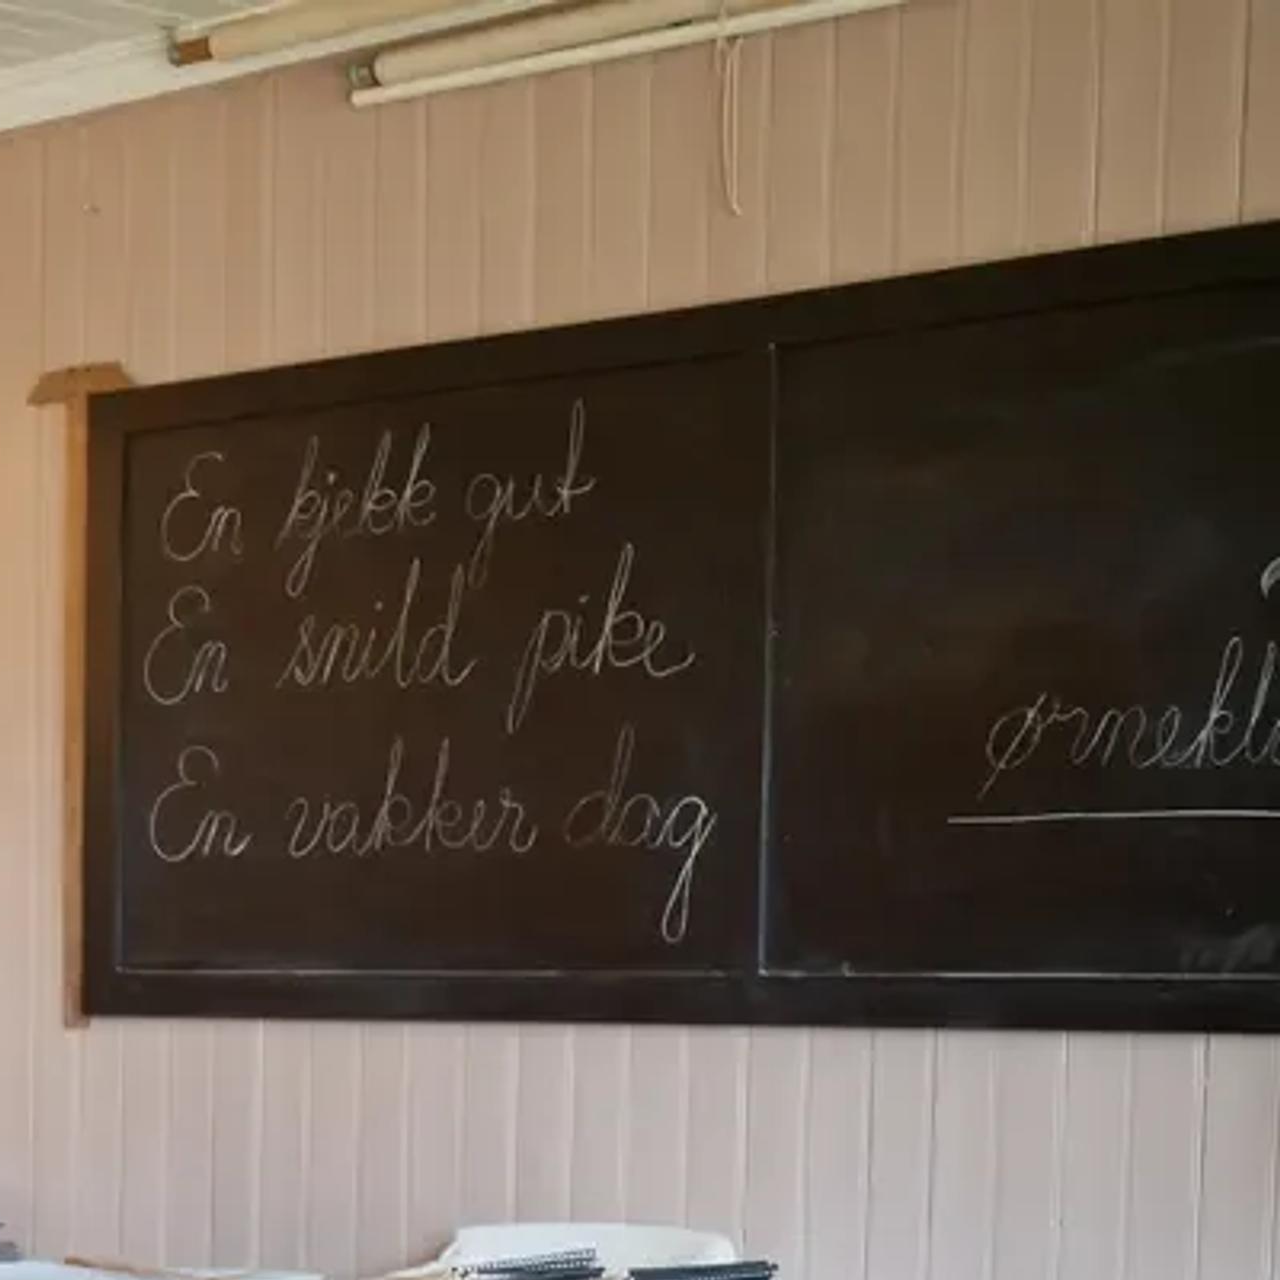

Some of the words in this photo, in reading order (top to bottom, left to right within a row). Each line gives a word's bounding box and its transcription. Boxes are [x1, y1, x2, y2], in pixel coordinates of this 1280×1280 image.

[160, 451, 244, 562] En
[275, 422, 438, 596] kjekk
[143, 585, 229, 705] En
[275, 557, 476, 690] snild
[506, 542, 696, 734] pike
[149, 745, 254, 863] En
[284, 737, 539, 858] vakker
[564, 724, 718, 944] dag
